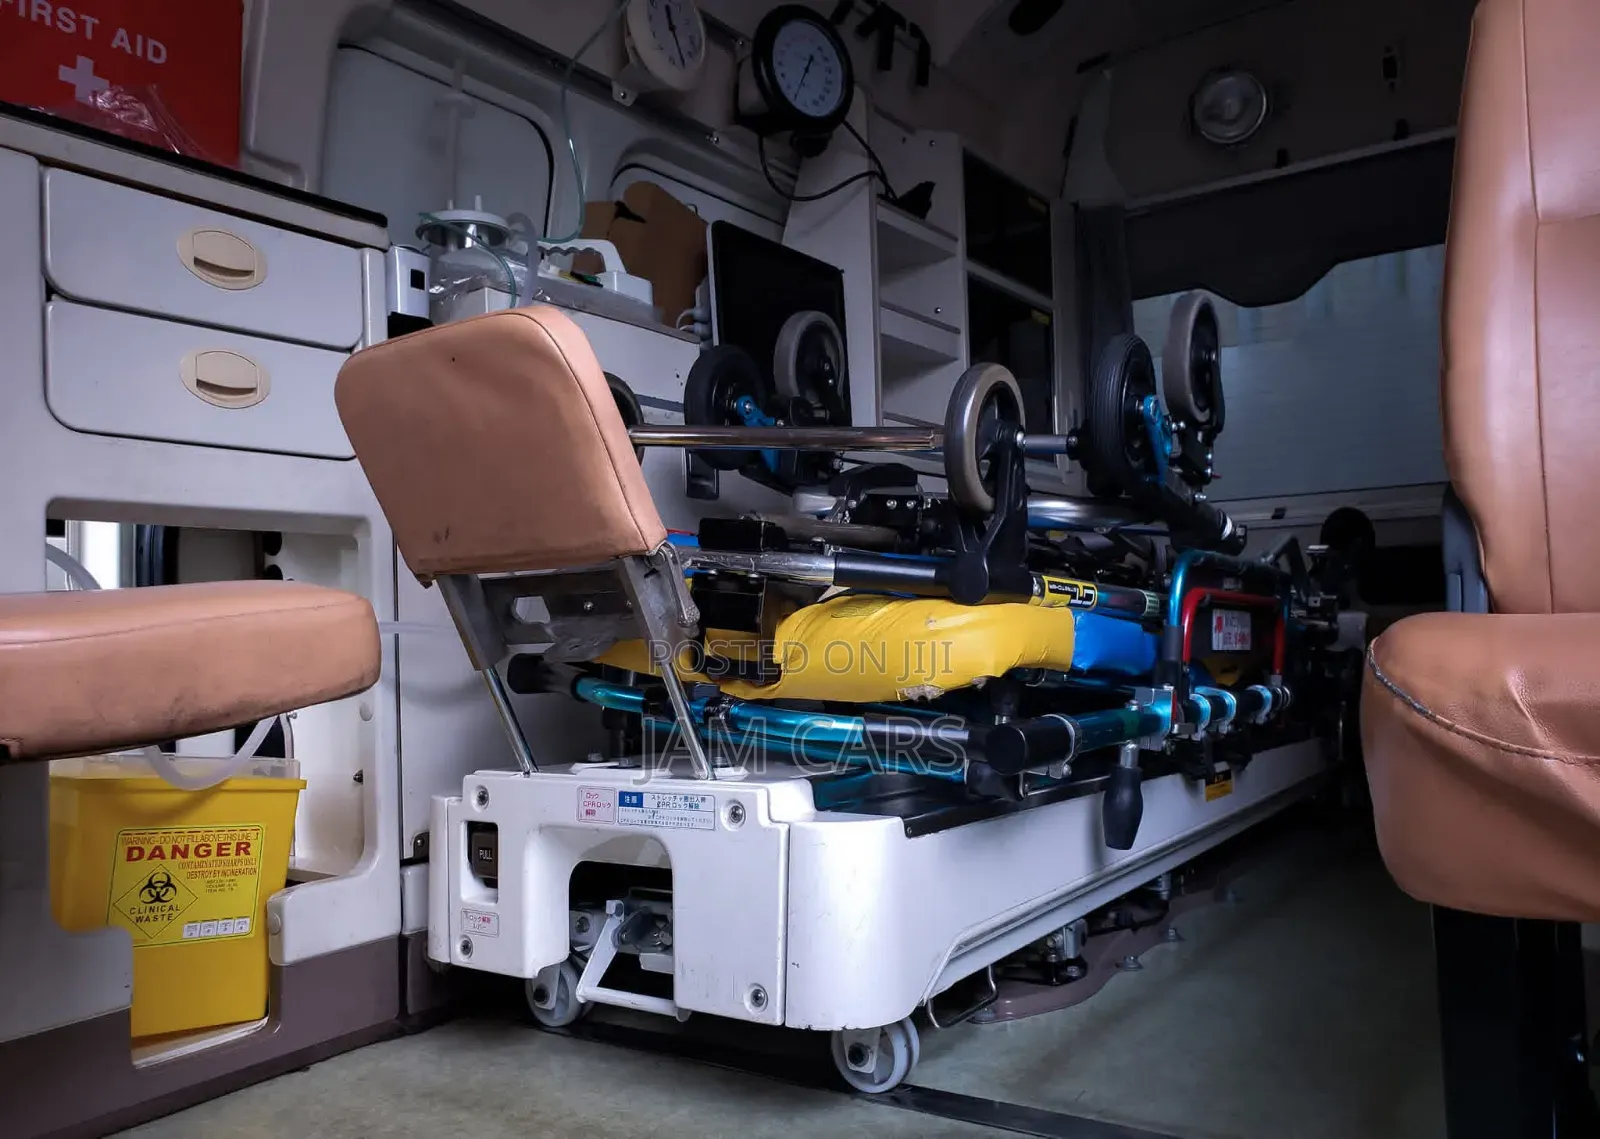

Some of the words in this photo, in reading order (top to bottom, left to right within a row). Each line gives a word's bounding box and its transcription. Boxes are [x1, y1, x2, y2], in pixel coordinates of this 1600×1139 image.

[110, 28, 167, 64] AID
[122, 836, 155, 845] WARNING
[160, 836, 171, 844] DO
[172, 835, 186, 844] NOT
[187, 835, 200, 843] FILL
[200, 833, 224, 842] ABOVE
[224, 833, 237, 841] THIS
[238, 832, 251, 841] LINE
[126, 841, 251, 862] DANGER
[479, 849, 493, 859] PULL
[186, 870, 213, 879] DESTROY
[213, 870, 220, 878] BY
[130, 904, 181, 915] CLINICAL
[135, 913, 173, 923] WASTE
